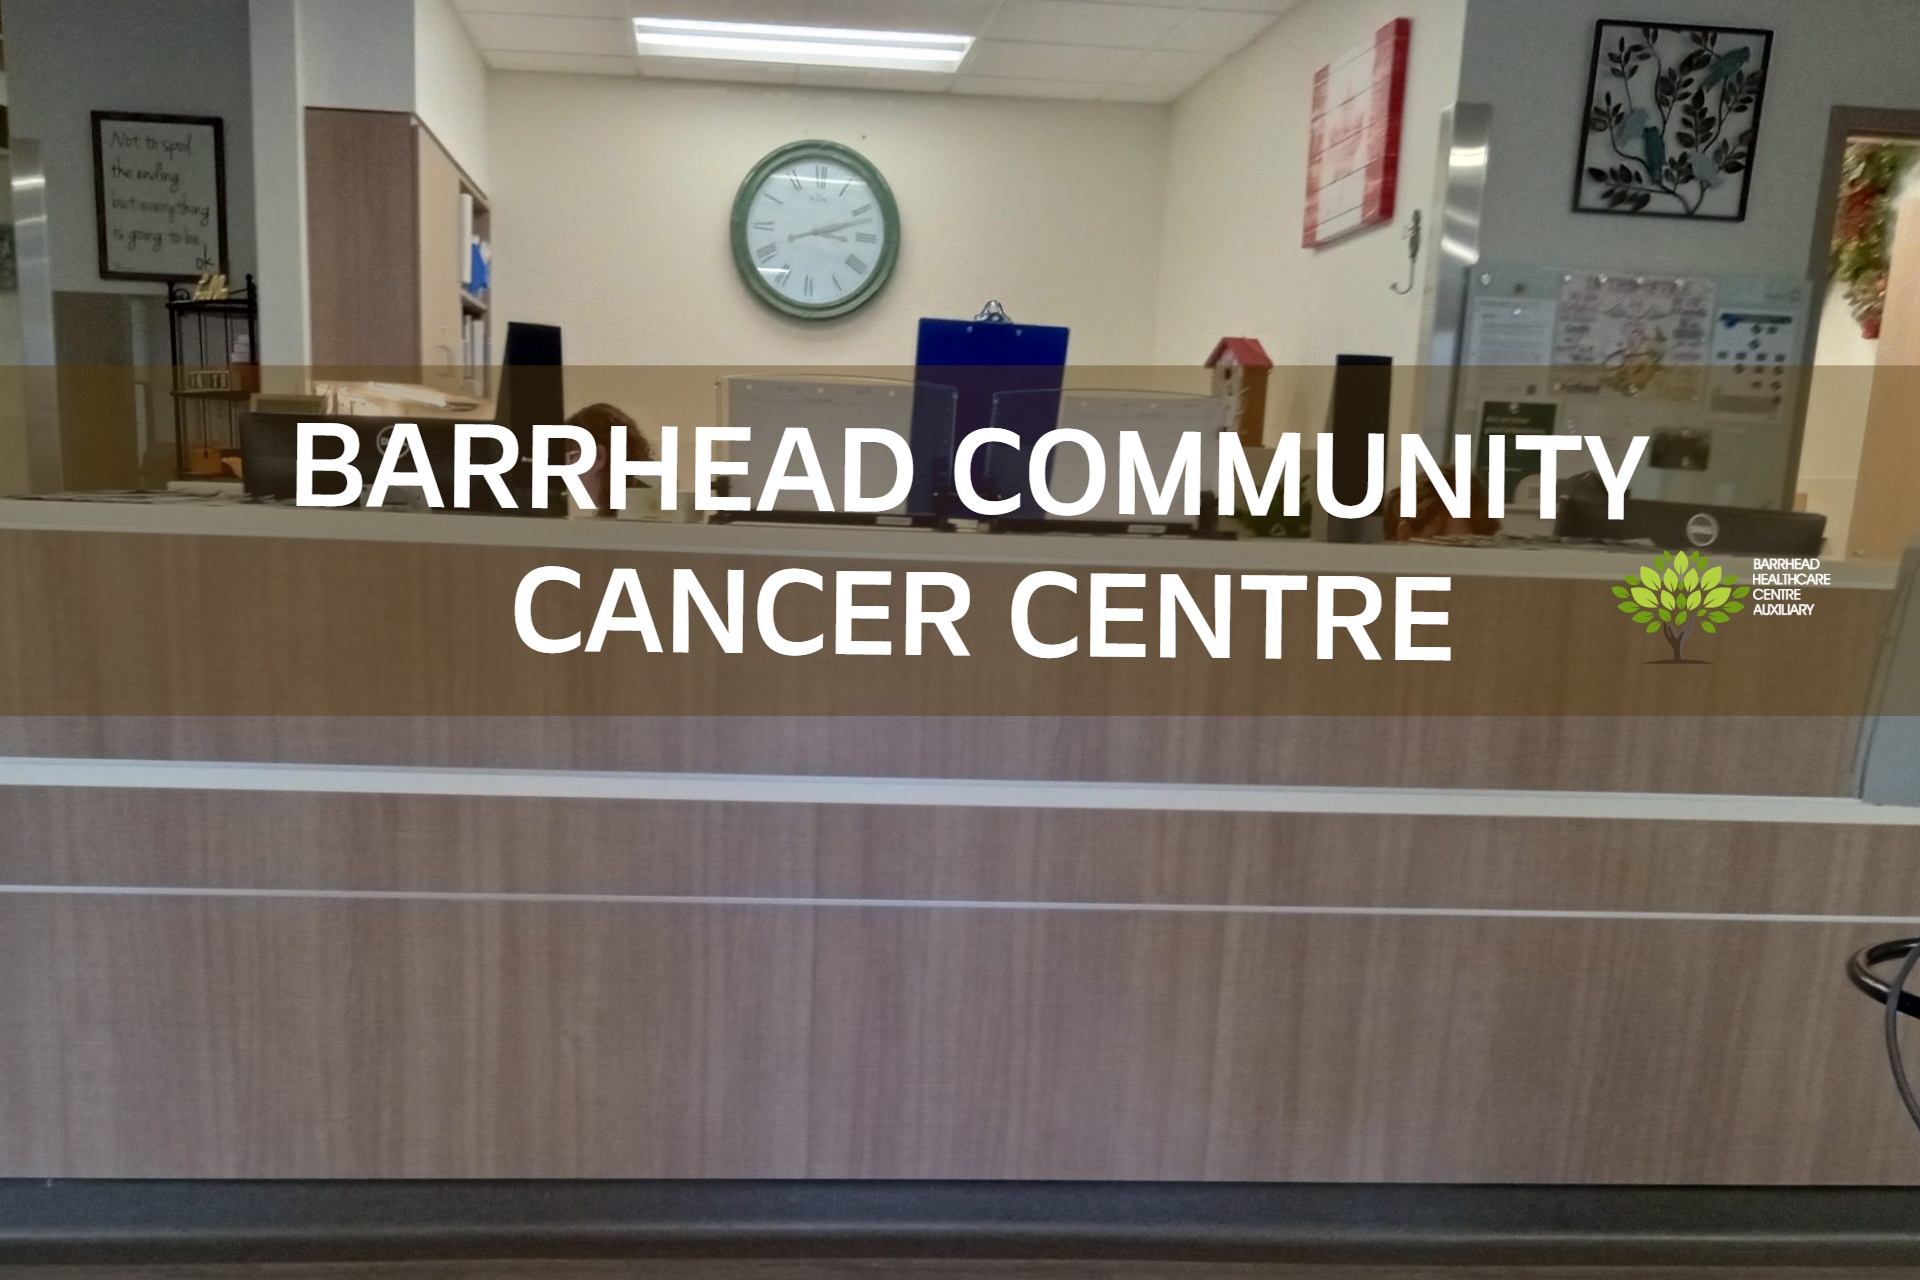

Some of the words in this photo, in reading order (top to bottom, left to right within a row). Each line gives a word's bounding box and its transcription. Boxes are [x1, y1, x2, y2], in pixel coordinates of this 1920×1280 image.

[109, 130, 140, 149] Not
[144, 135, 159, 150] to
[111, 155, 133, 178] the
[136, 161, 180, 193] ending
[127, 230, 163, 253] going
[167, 232, 182, 245] to
